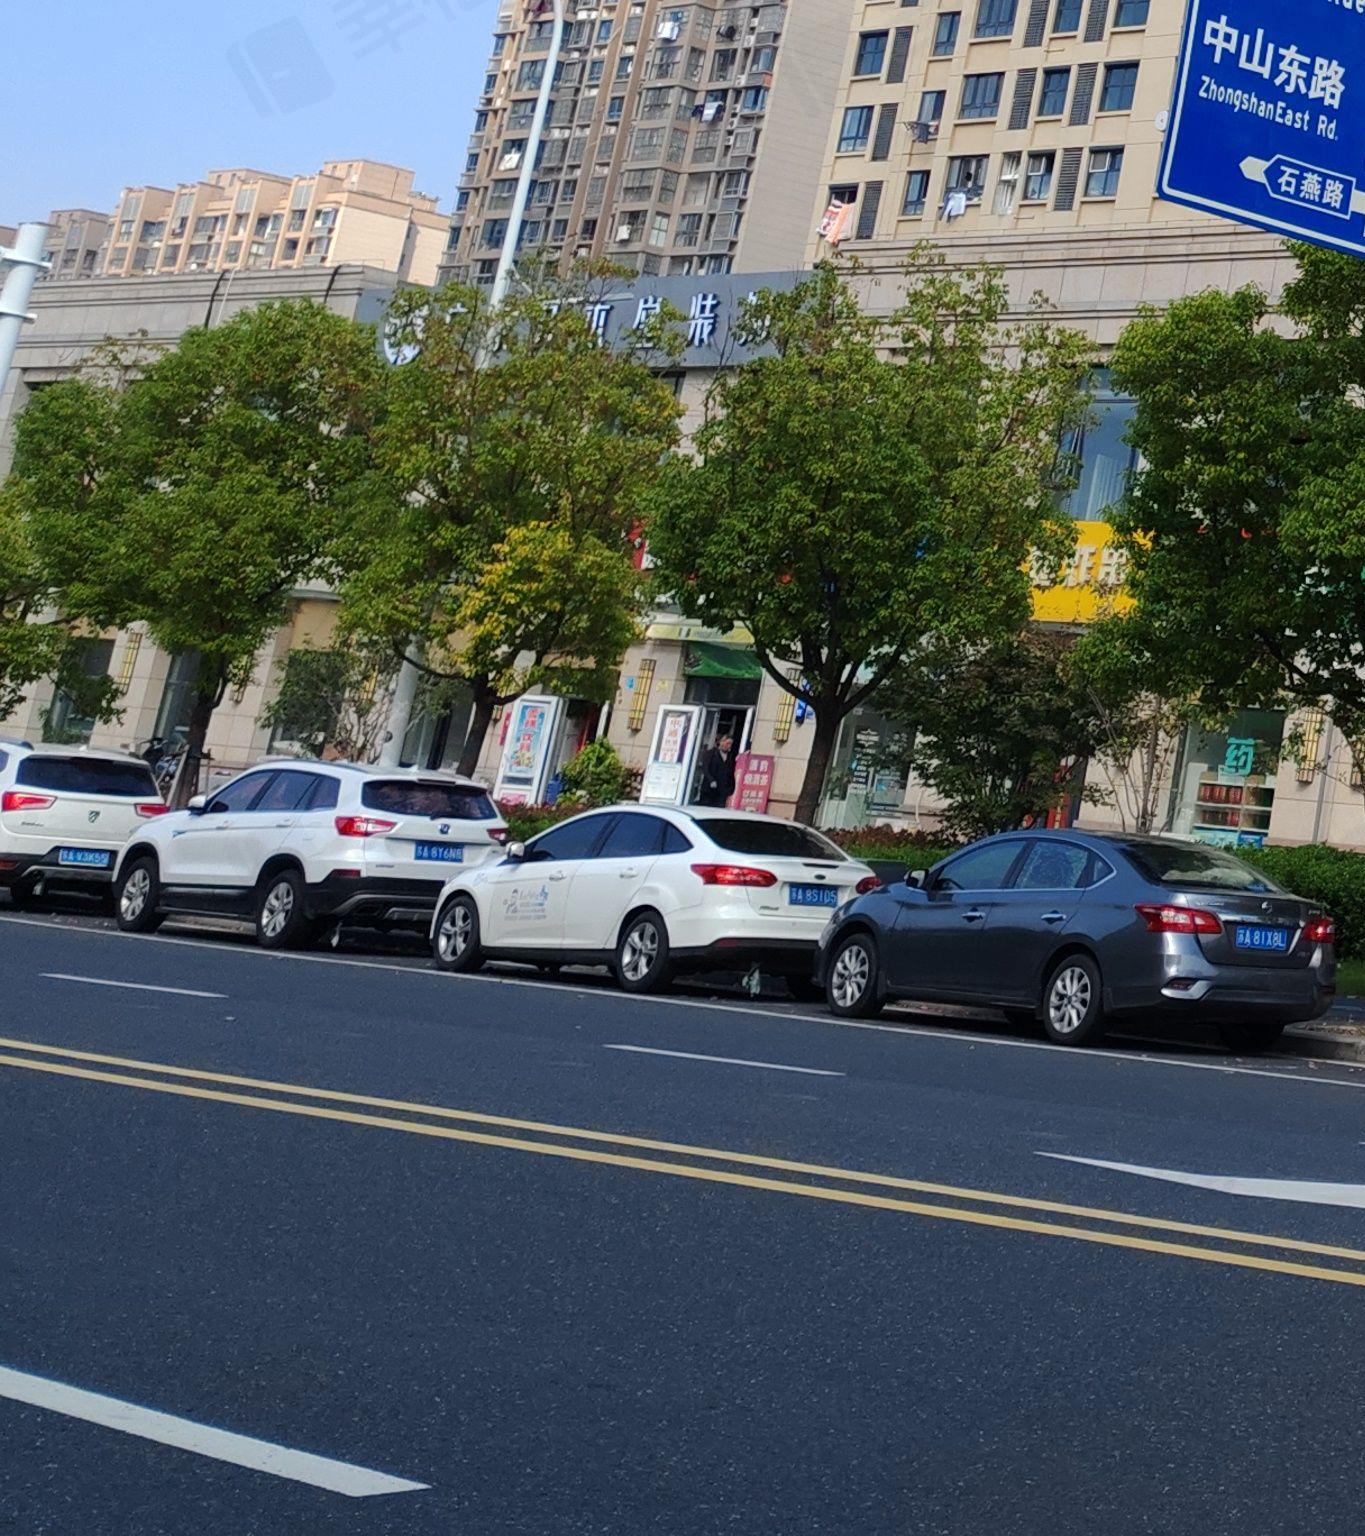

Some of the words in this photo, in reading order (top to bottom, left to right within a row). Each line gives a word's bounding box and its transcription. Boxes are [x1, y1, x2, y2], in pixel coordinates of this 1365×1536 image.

[1203, 14, 1346, 110] 中山东路
[1317, 118, 1339, 141] Rd.
[1277, 165, 1345, 208] 石燕路
[1225, 738, 1255, 776] 药
